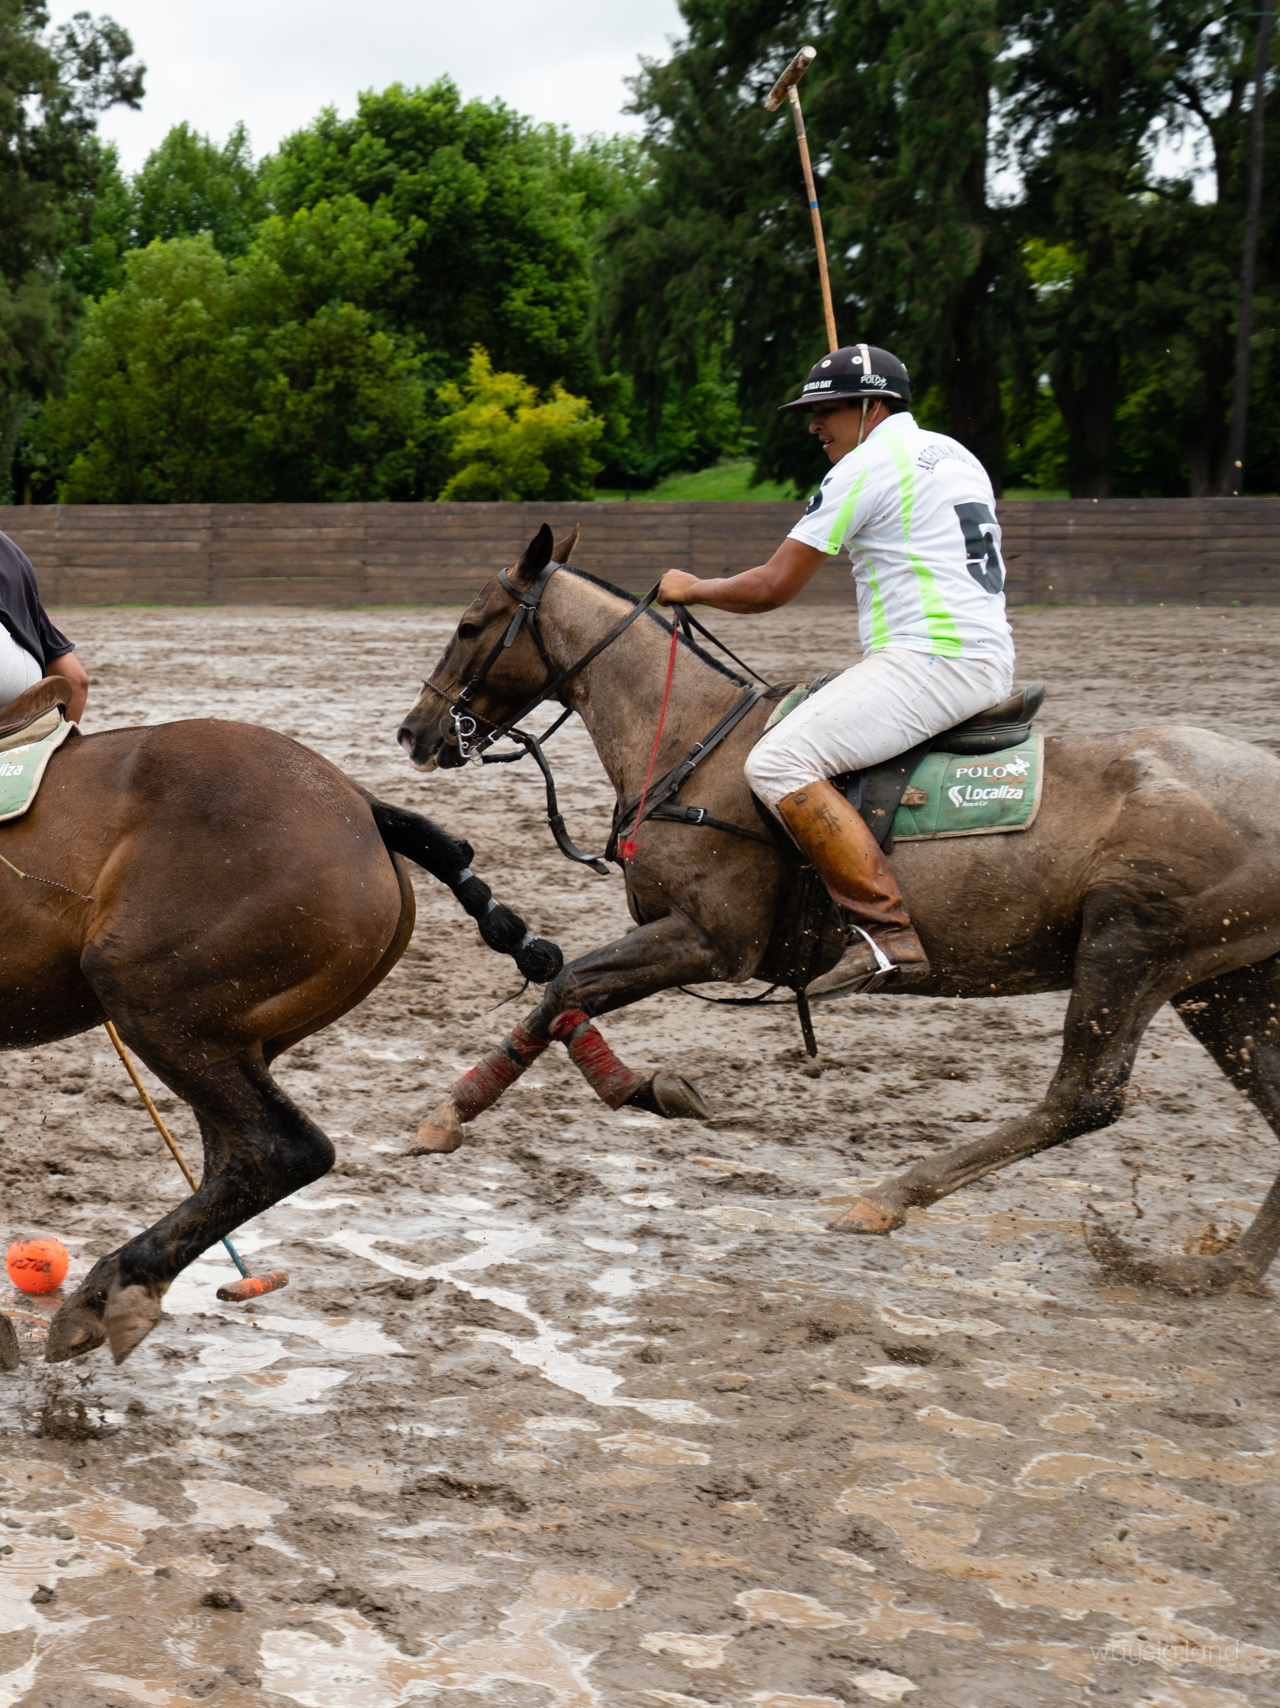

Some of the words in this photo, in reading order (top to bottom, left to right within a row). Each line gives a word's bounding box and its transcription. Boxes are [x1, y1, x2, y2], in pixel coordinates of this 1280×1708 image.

[860, 375, 881, 384] POLO
[954, 502, 1003, 594] 5
[956, 767, 1007, 778] POLO
[966, 785, 1024, 800] Localiza
